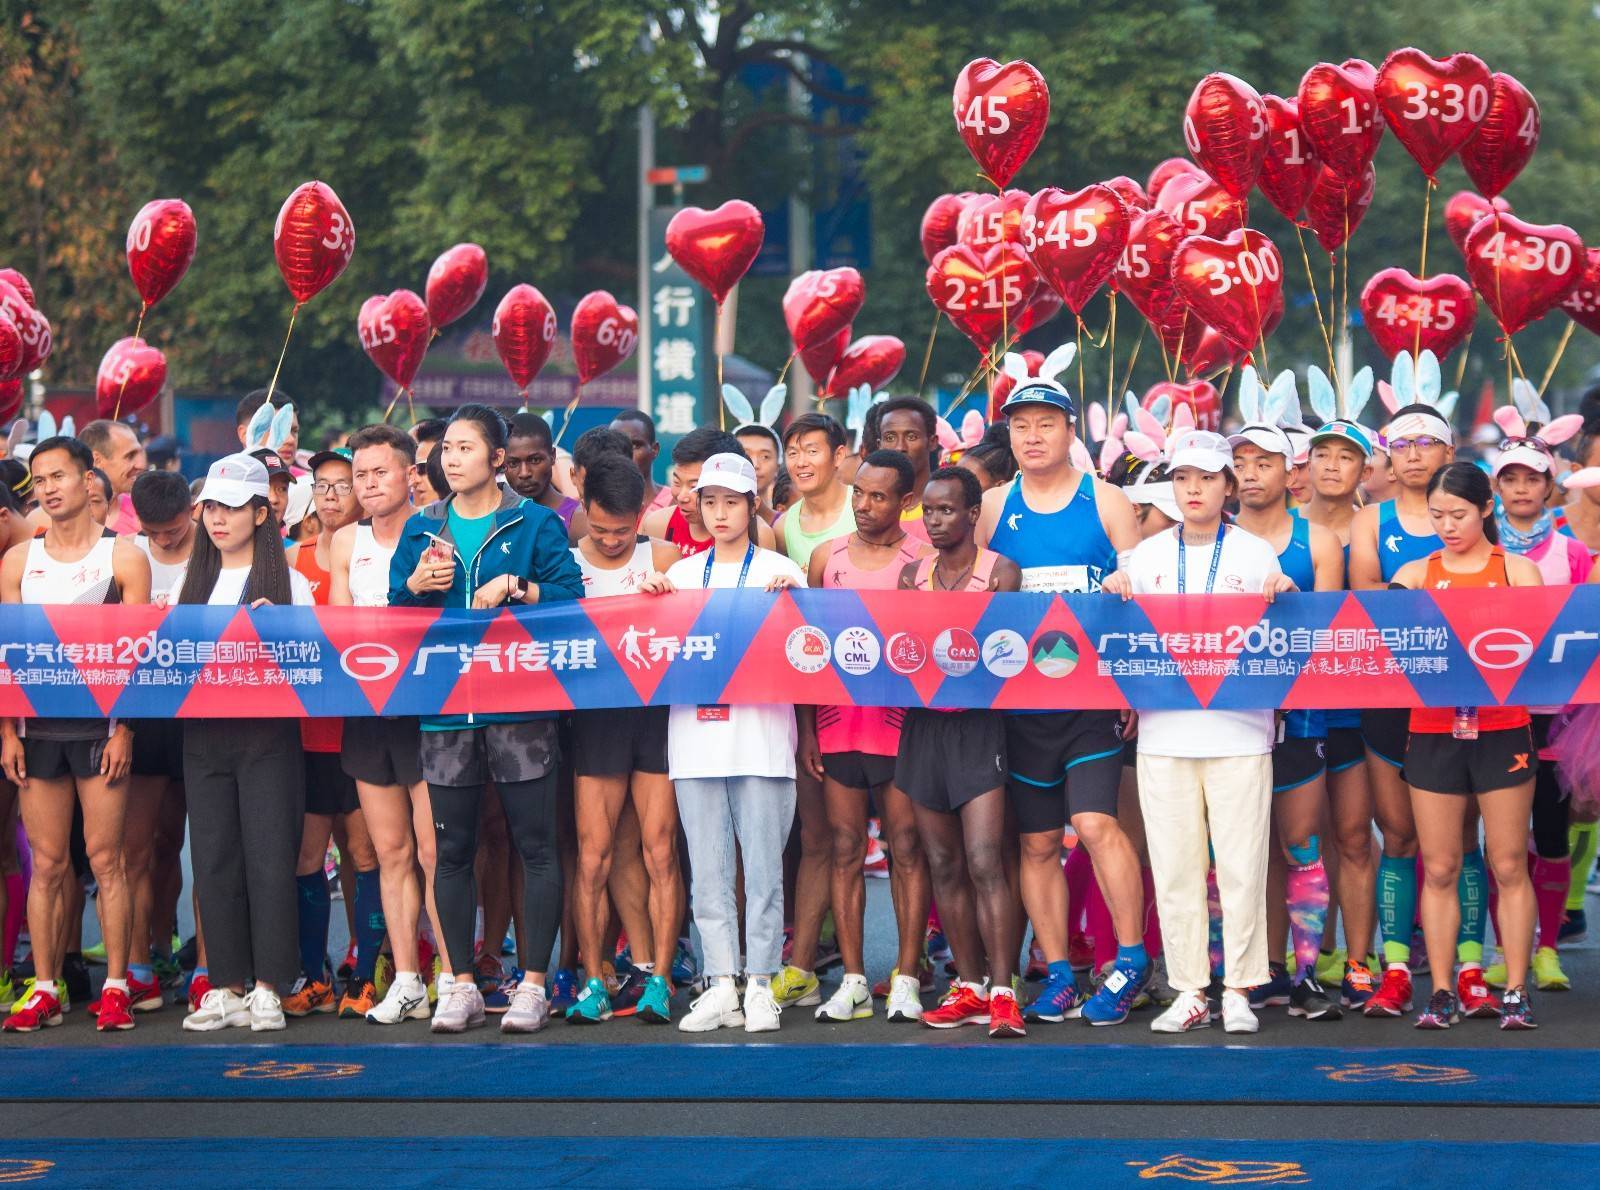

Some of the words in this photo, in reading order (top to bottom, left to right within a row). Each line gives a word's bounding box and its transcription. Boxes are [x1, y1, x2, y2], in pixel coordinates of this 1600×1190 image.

[1403, 82, 1488, 122] 3:30
[1023, 208, 1097, 252] 3:45
[1203, 247, 1279, 295] 3:00
[1480, 232, 1572, 275] 4:30
[945, 275, 1023, 310] 2:15
[1376, 295, 1456, 330] 4:45
[413, 638, 597, 676] 广汽传祺
[845, 652, 871, 663] CML
[951, 648, 976, 658] CAA
[1380, 870, 1402, 935] kalenji
